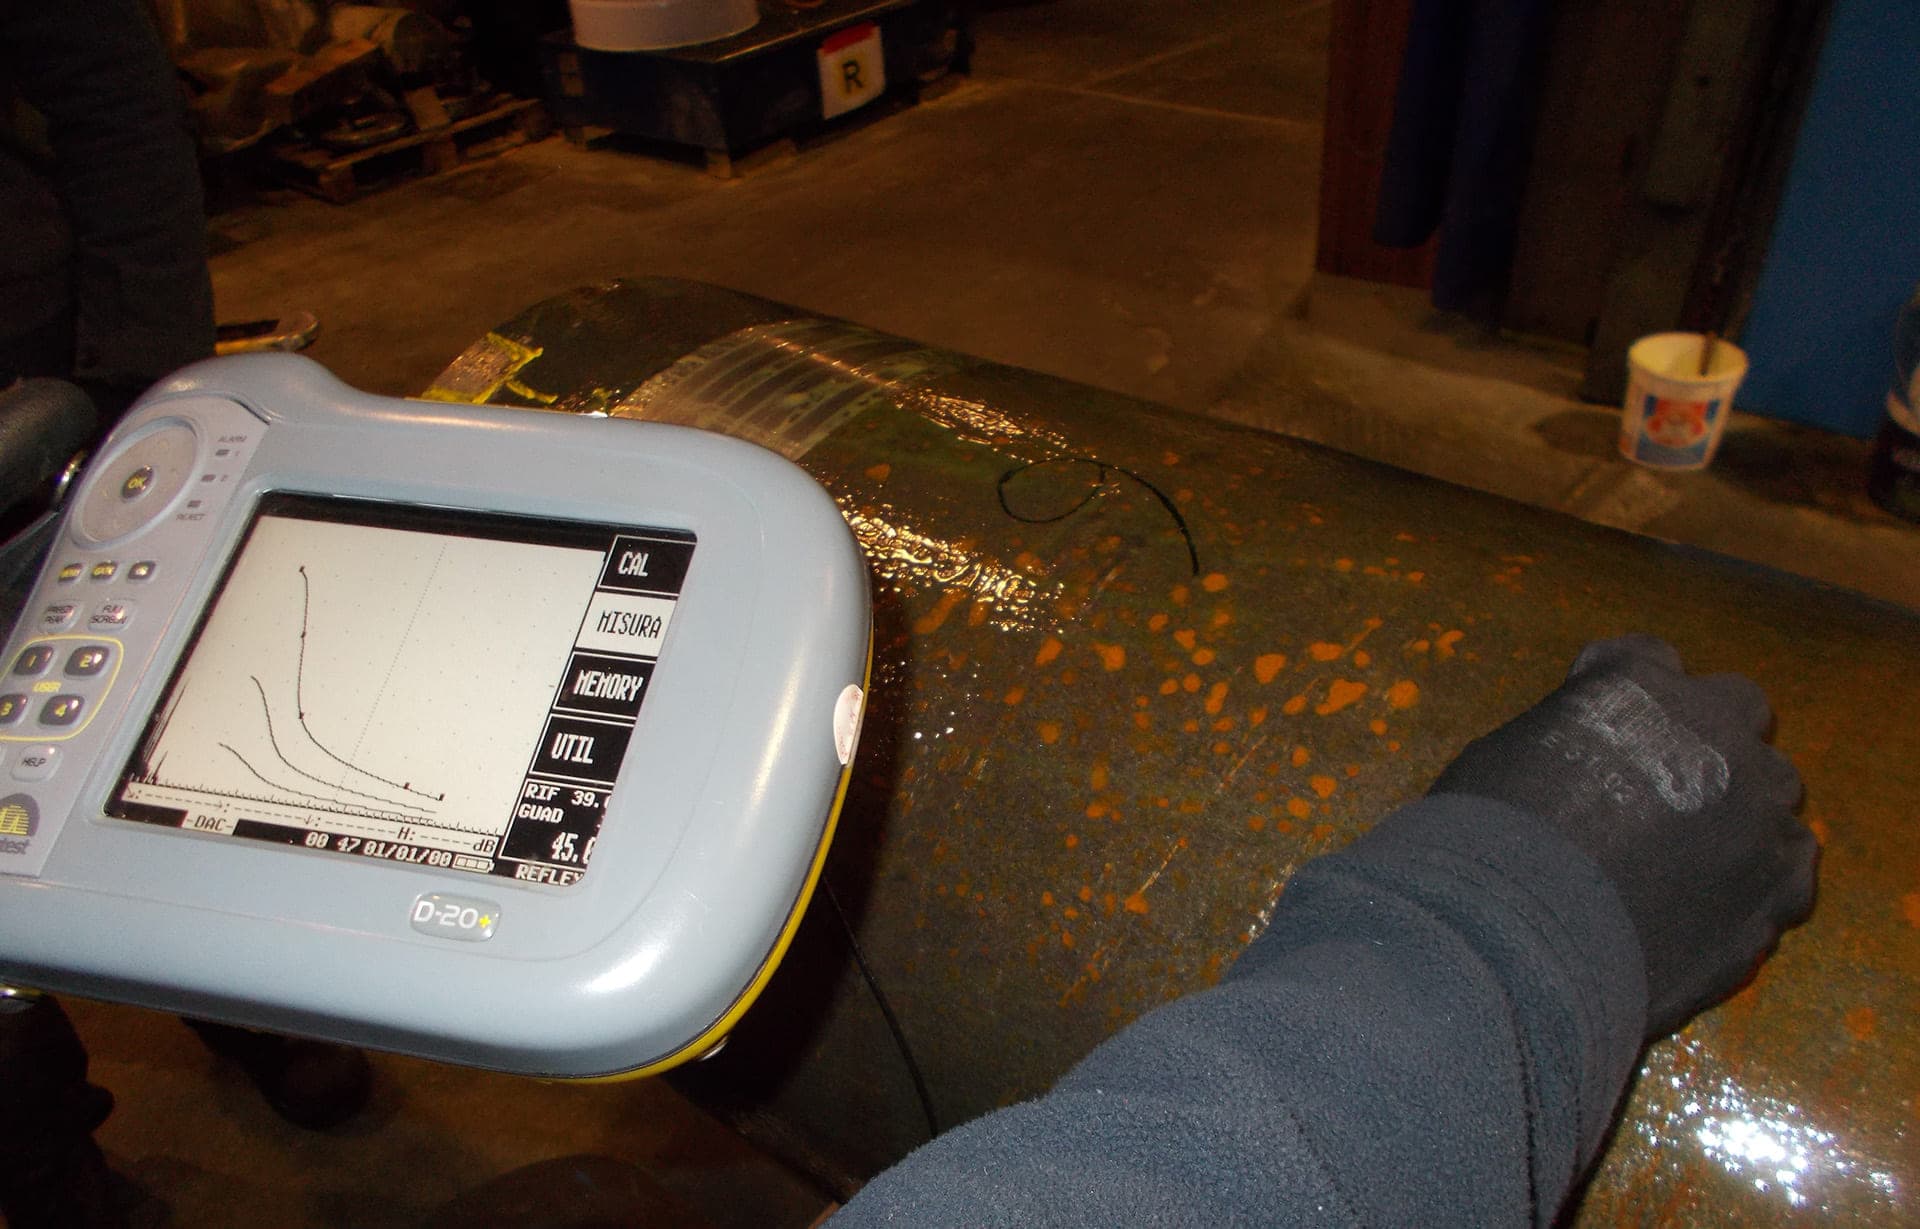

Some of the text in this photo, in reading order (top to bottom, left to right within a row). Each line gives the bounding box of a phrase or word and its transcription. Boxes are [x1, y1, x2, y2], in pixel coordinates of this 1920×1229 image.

[842, 60, 864, 93] R
[128, 476, 147, 489] OK
[618, 551, 649, 577] CAL
[597, 610, 662, 639] MISURA
[27, 655, 37, 668] 1
[79, 654, 93, 668] 2
[32, 681, 62, 693] USER
[573, 669, 644, 702] MEMORY
[1, 702, 13, 716] 3
[54, 703, 68, 718] 4
[551, 733, 595, 765] UTIL
[22, 757, 47, 768] HELP
[525, 783, 561, 801] RIF
[519, 803, 564, 824] GUAD
[337, 836, 362, 853] 47
[472, 838, 497, 853] dB
